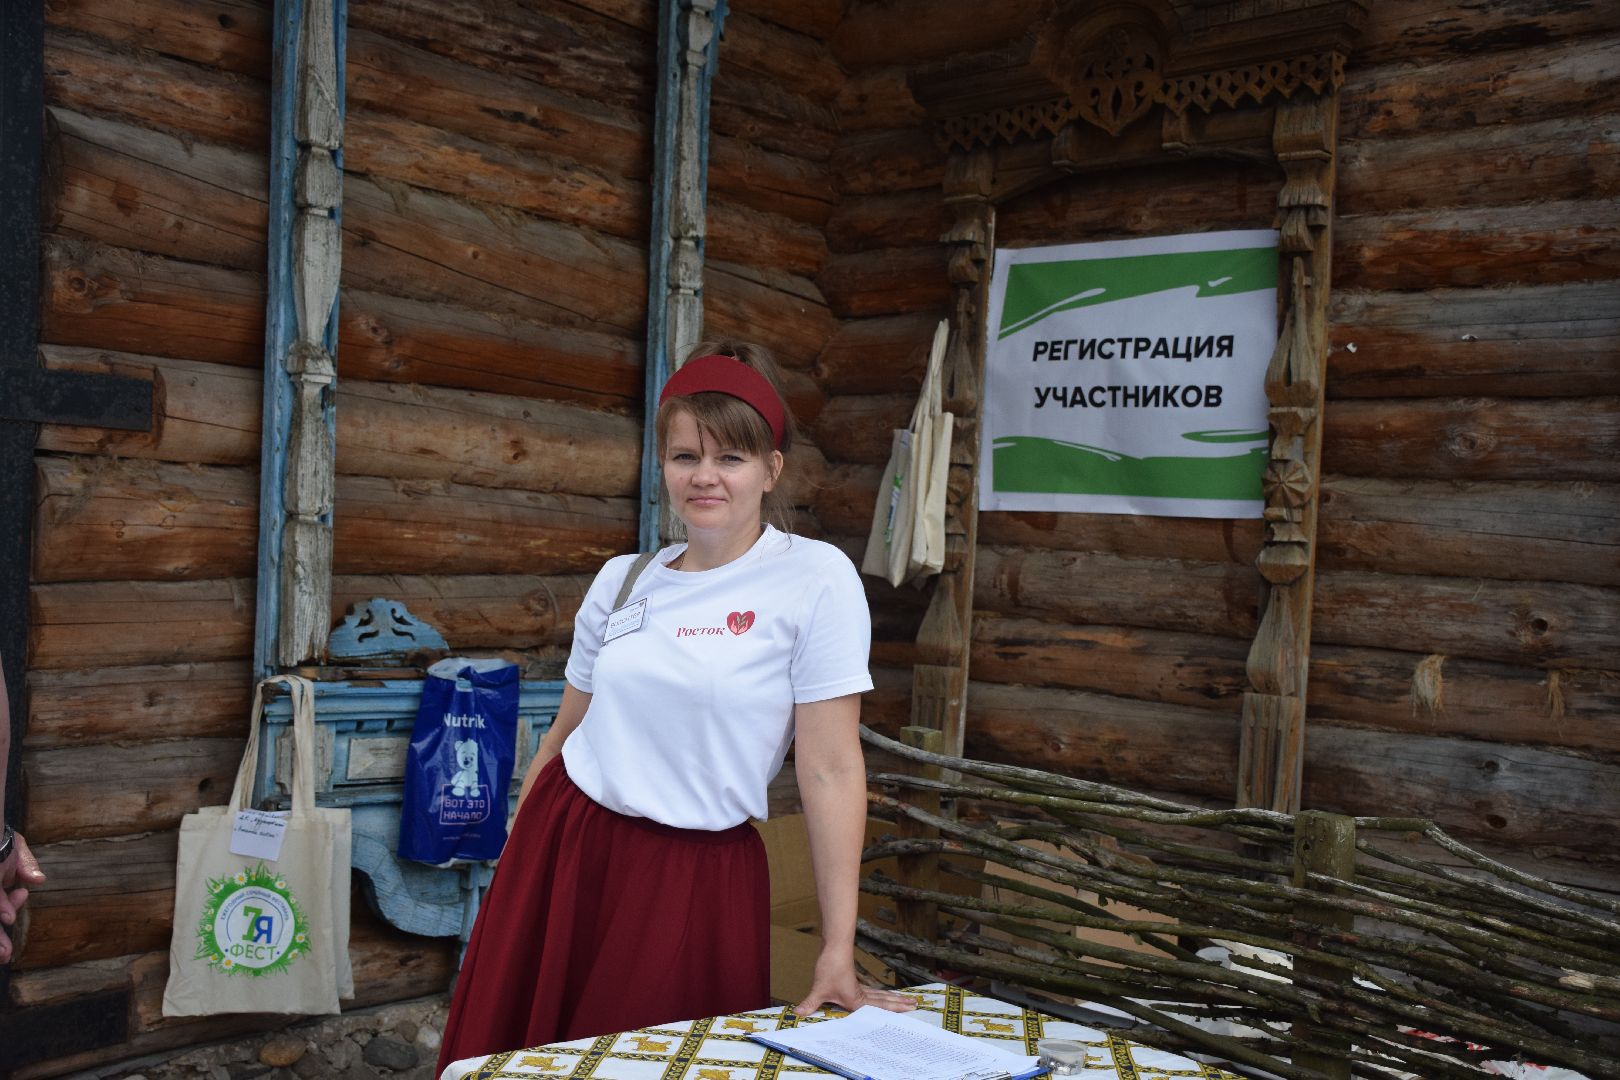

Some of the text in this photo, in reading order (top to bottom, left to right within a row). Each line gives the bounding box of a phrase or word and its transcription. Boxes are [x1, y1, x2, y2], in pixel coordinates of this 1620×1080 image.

[1032, 335, 1234, 362] РЕГИСТРАЦИЯ
[1034, 385, 1223, 408] УЧАСТНИКОВ
[444, 713, 486, 729] Nutrik
[445, 799, 485, 809] ВОТ ЭТО
[443, 811, 483, 821] НАЧАЛО
[230, 944, 278, 961] ФЕСТ
